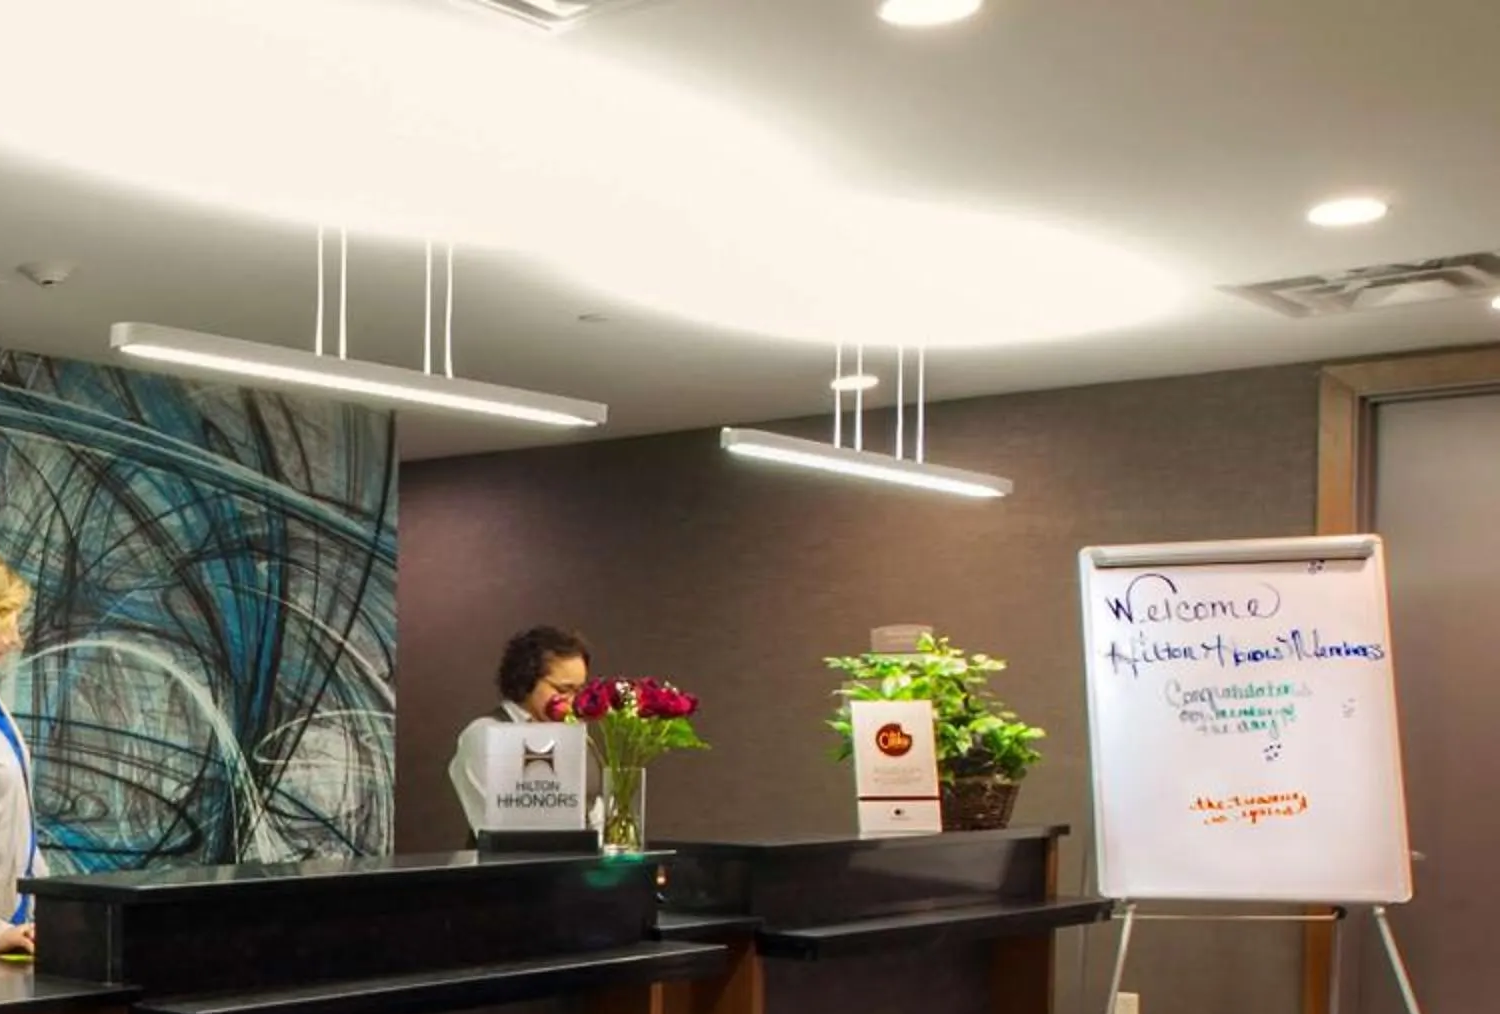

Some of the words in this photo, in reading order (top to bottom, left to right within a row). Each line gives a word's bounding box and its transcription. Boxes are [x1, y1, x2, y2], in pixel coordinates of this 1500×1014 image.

[1105, 573, 1280, 623] Welcome
[516, 780, 560, 792] HILTON
[497, 793, 579, 809] HHONORS
